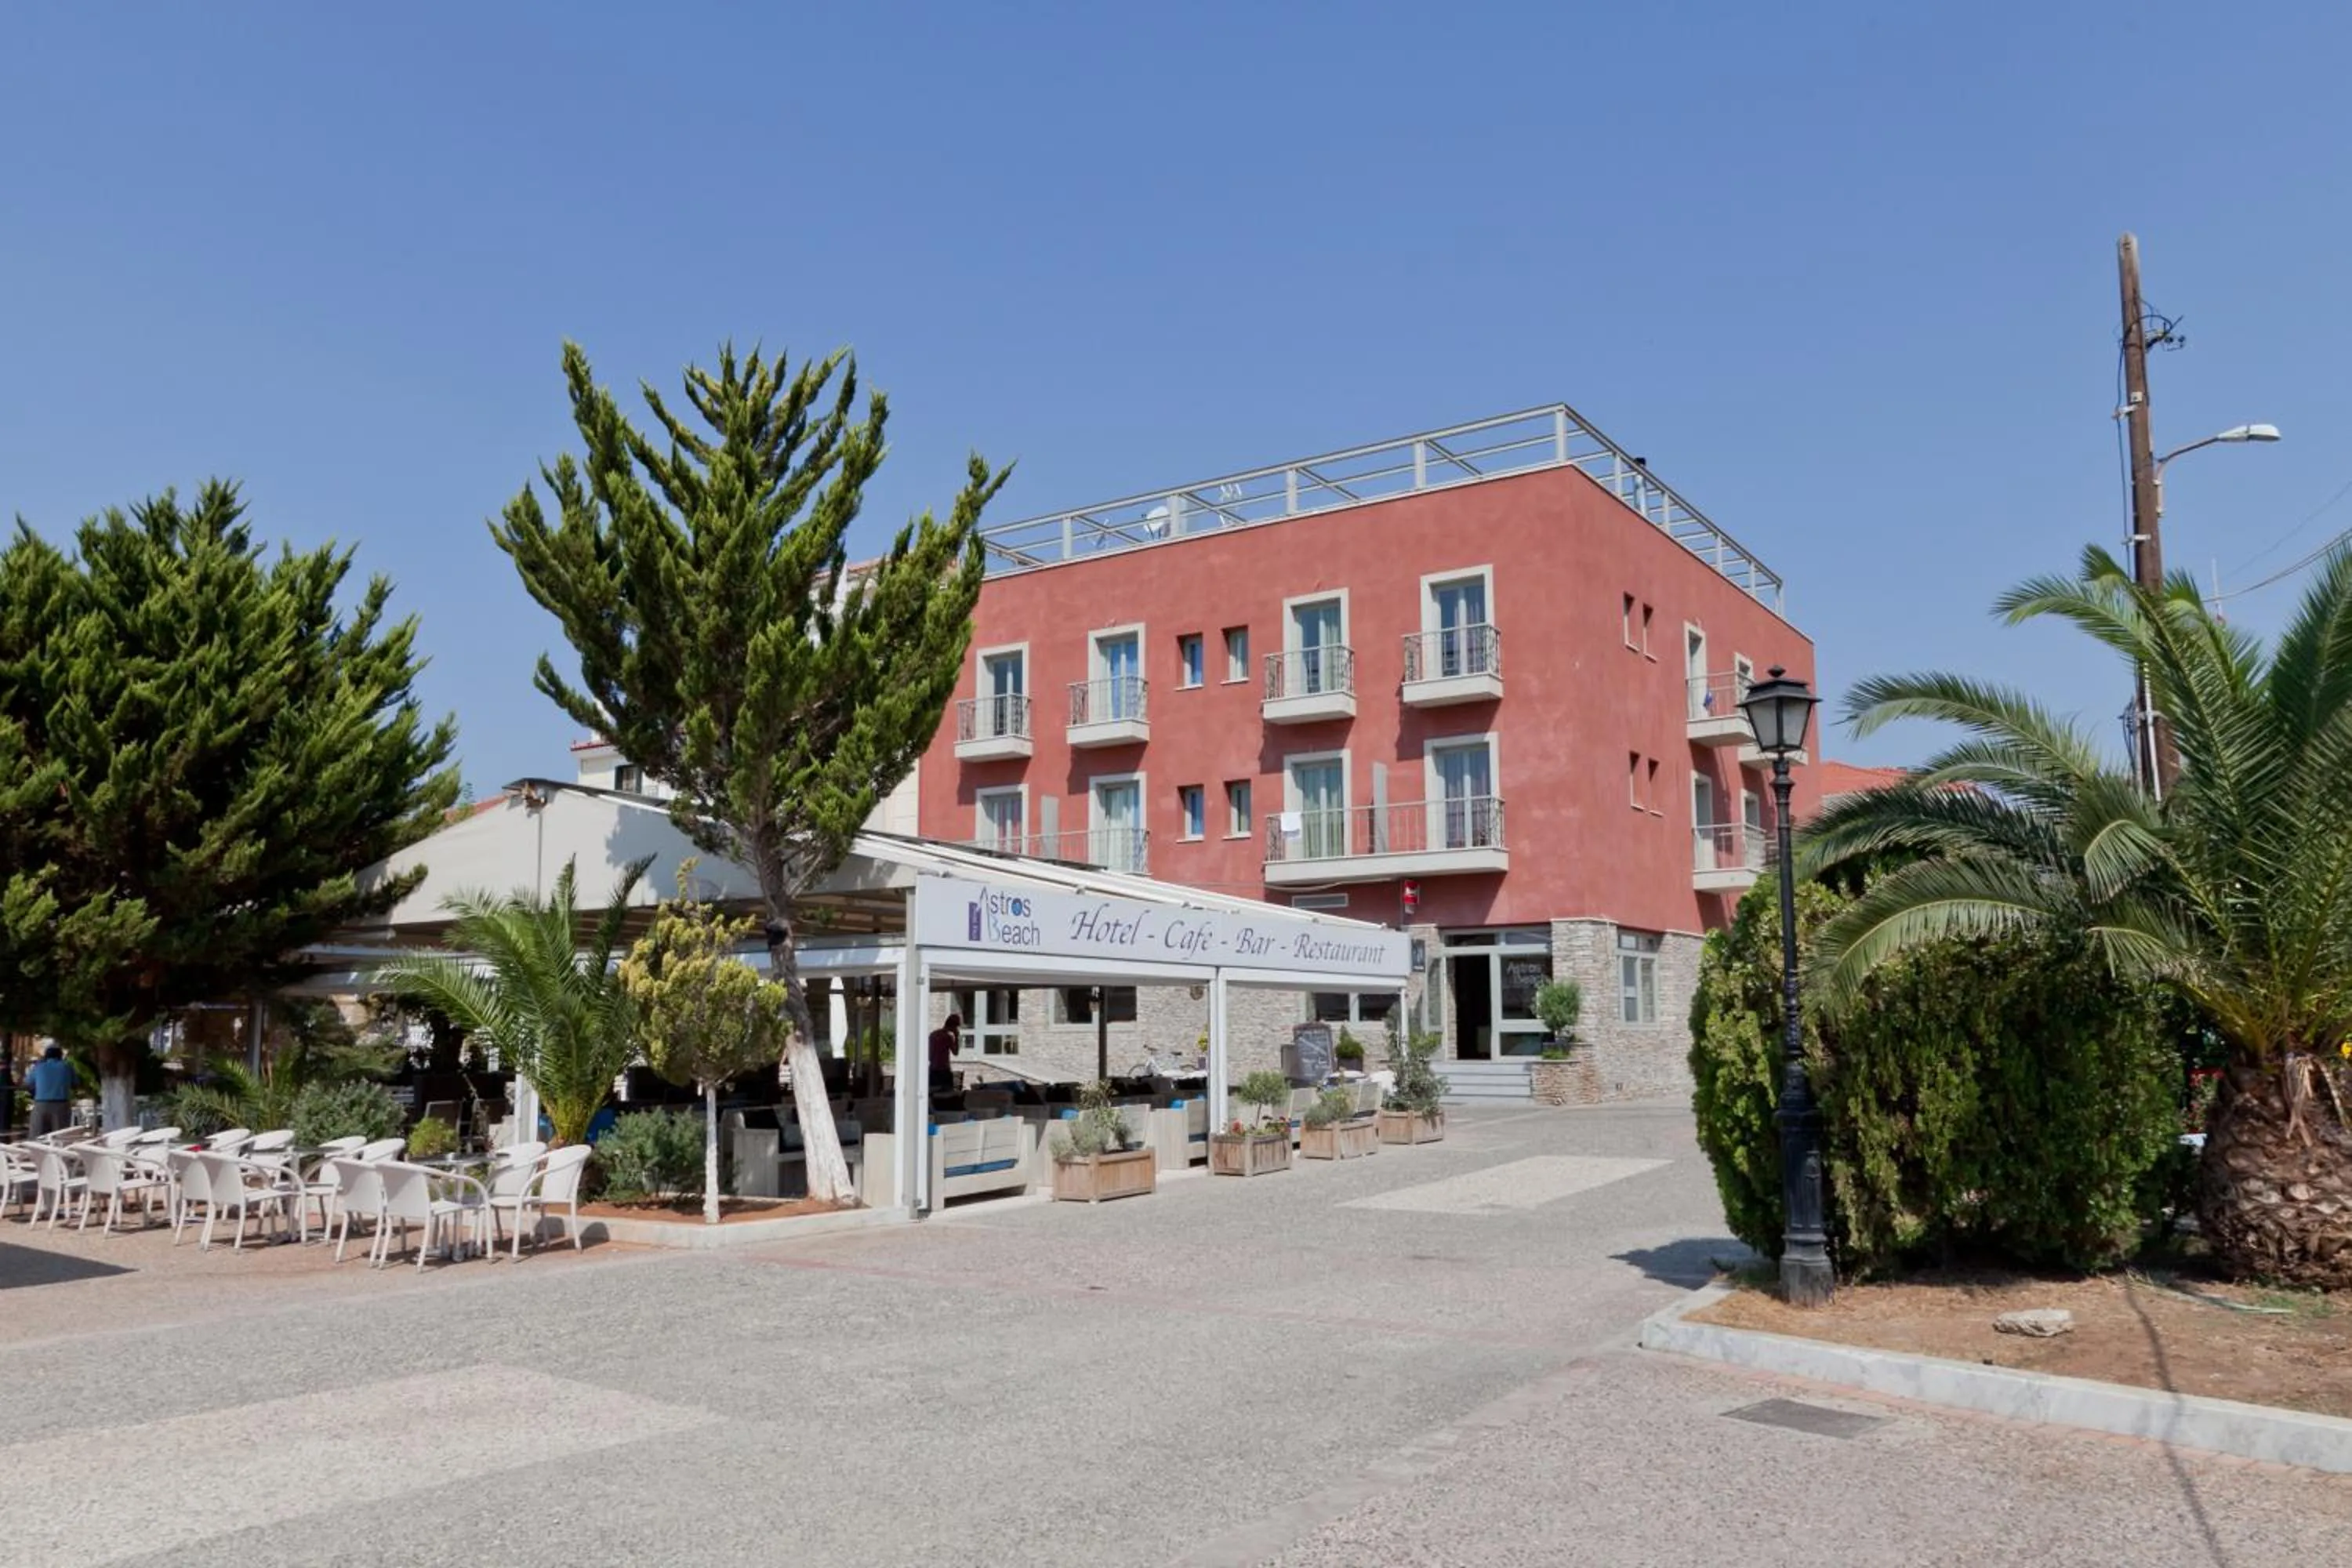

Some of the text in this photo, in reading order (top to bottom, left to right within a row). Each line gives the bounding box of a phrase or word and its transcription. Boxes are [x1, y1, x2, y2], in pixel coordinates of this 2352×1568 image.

[979, 886, 1031, 918] Astros
[987, 913, 1040, 946] Beach
[1070, 902, 1151, 946] Hotel
[1236, 927, 1276, 955] Bar
[1294, 933, 1386, 964] Restaurant
